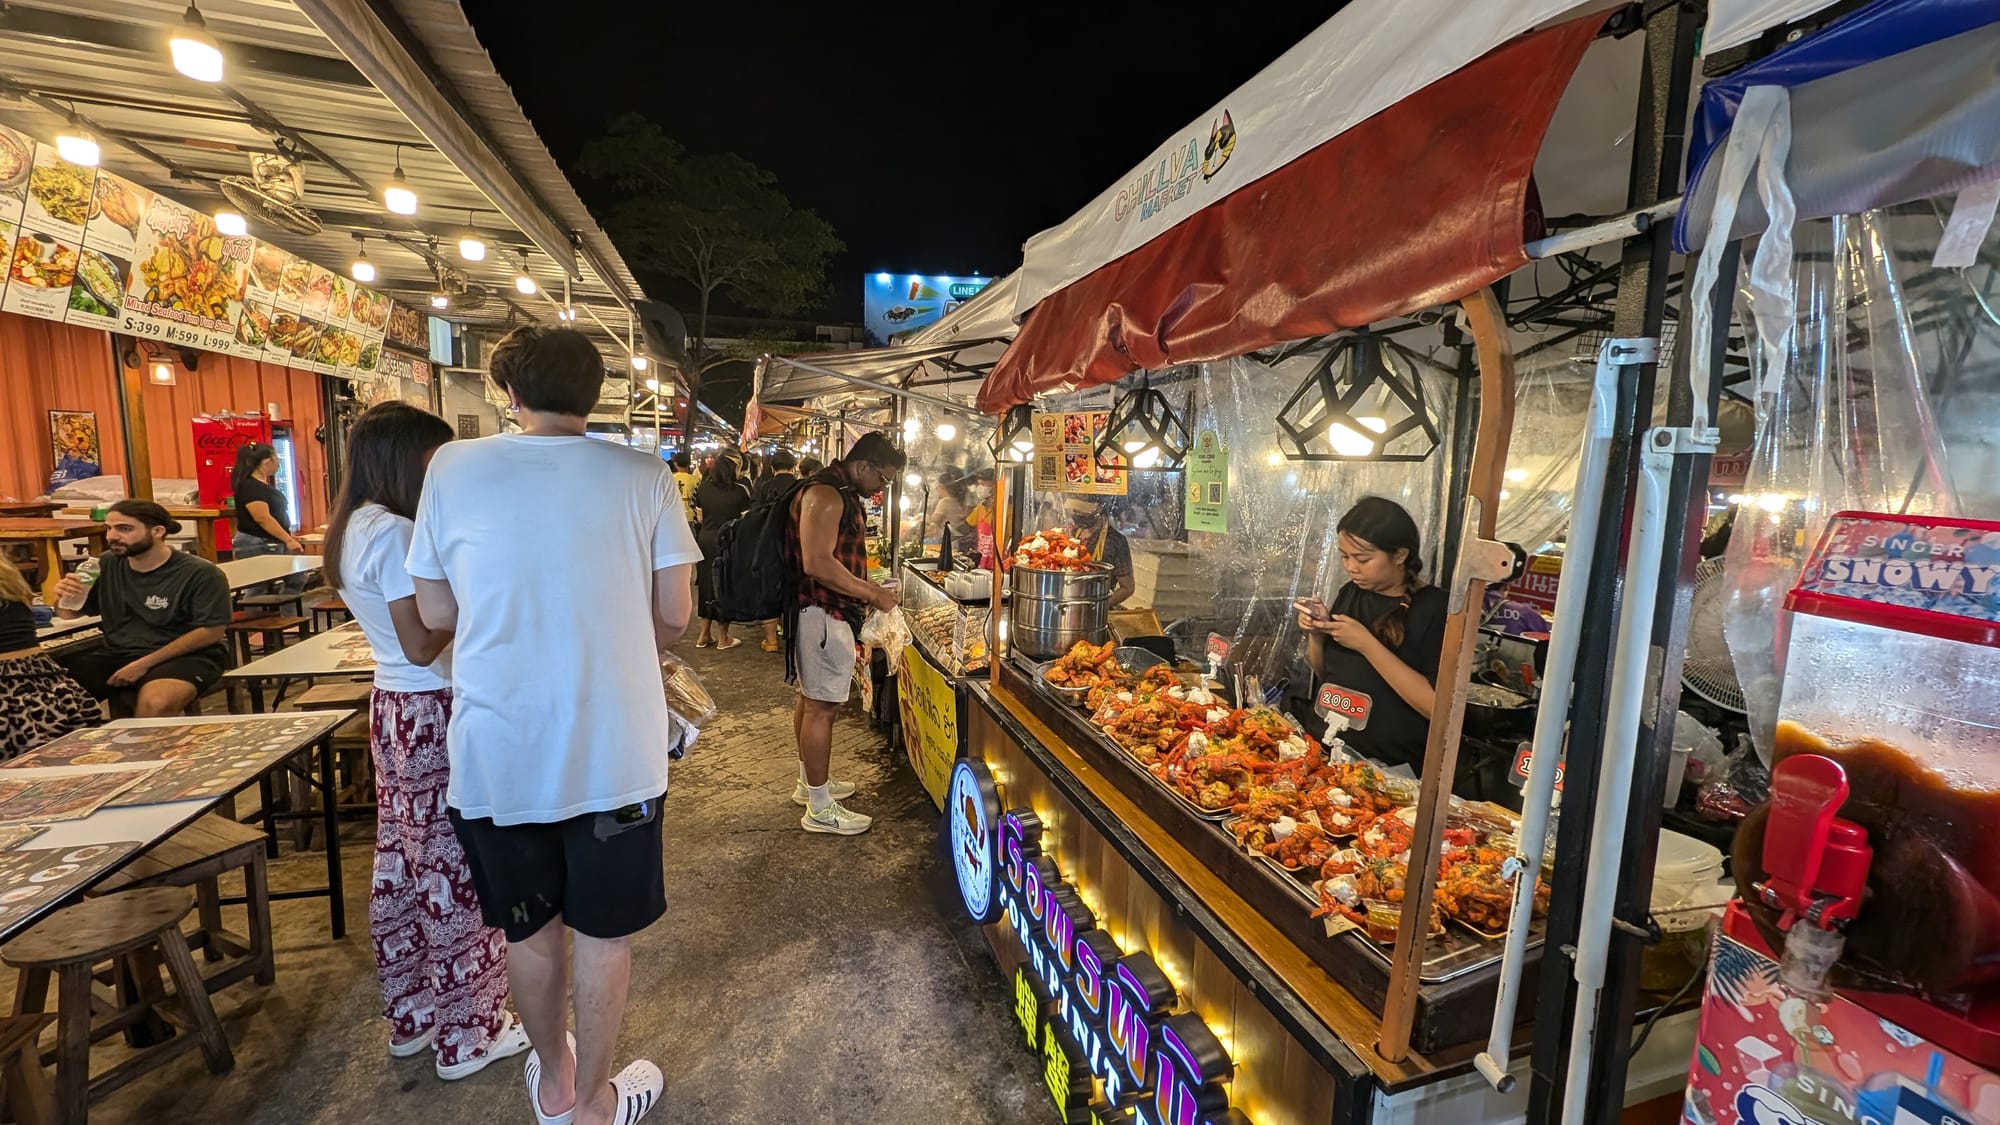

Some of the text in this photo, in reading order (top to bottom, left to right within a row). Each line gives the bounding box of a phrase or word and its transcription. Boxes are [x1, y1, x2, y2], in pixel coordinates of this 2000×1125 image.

[1115, 138, 1199, 222] CHILLVA
[1140, 171, 1198, 222] MARKET
[953, 286, 974, 296] LINE
[126, 296, 151, 313] Mixed
[152, 303, 184, 322] Seafood
[124, 317, 160, 336] S:399
[166, 326, 199, 344] M:599
[204, 335, 230, 350] L:999
[1863, 535, 1964, 558] SINGER
[1822, 557, 1998, 594] SNOWY
[1322, 691, 1364, 714] 200.-
[1797, 1073, 1880, 1125] SIN
